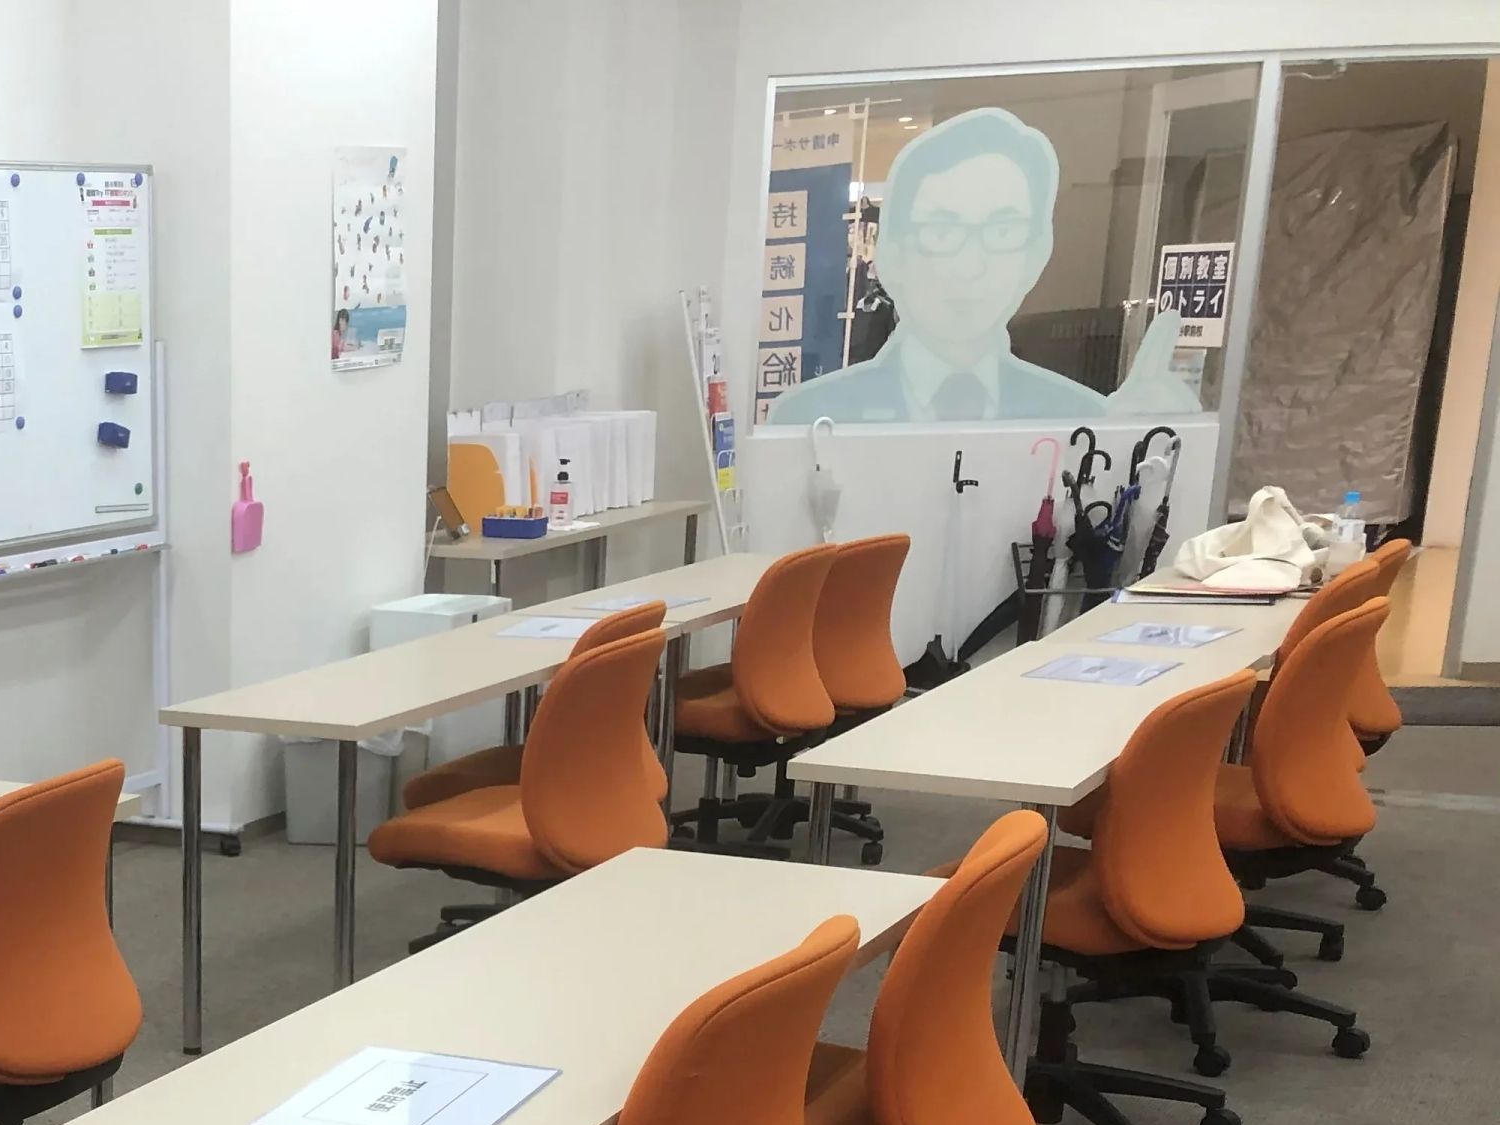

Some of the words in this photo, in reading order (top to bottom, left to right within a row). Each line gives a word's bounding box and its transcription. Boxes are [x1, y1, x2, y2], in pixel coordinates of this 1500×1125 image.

[1164, 254, 1228, 281] 個別教室
[1160, 288, 1223, 314] のトライ
[364, 1079, 428, 1112] 使用禁止
